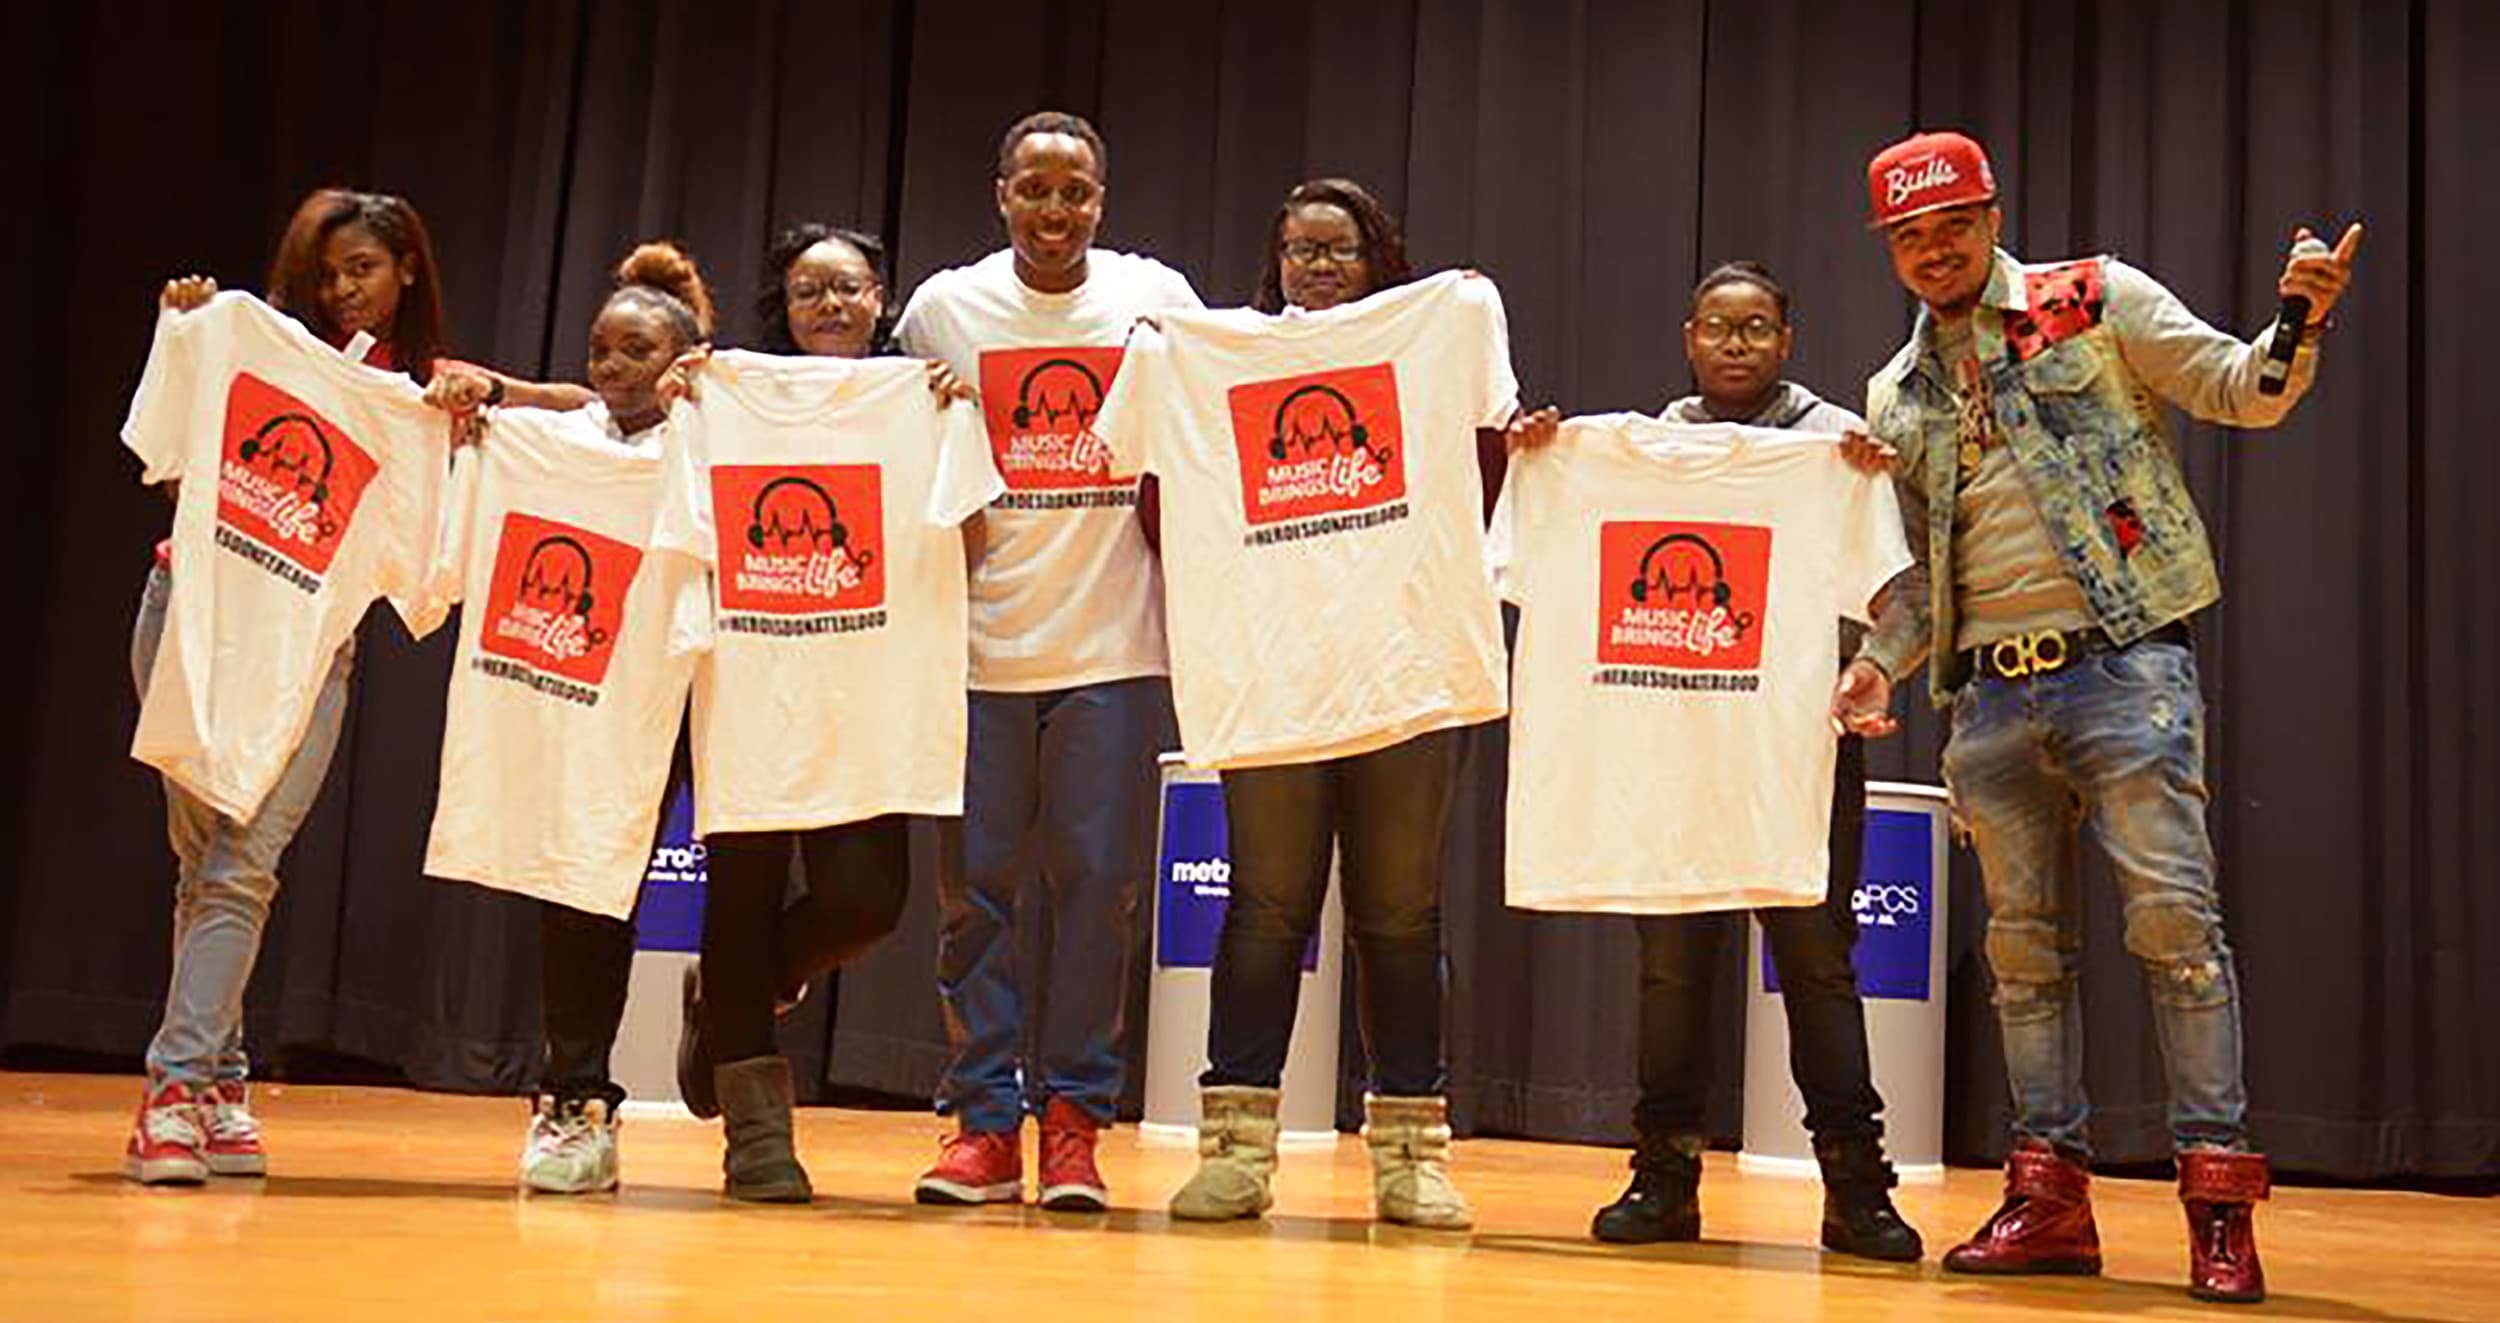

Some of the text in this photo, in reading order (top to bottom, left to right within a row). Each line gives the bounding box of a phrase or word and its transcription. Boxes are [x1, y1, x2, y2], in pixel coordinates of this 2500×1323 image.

[1884, 158, 1959, 208] Bulls
[1267, 458, 1329, 484] MUSIC
[744, 552, 808, 575] MUSIC
[1622, 607, 1689, 626] MUSIC
